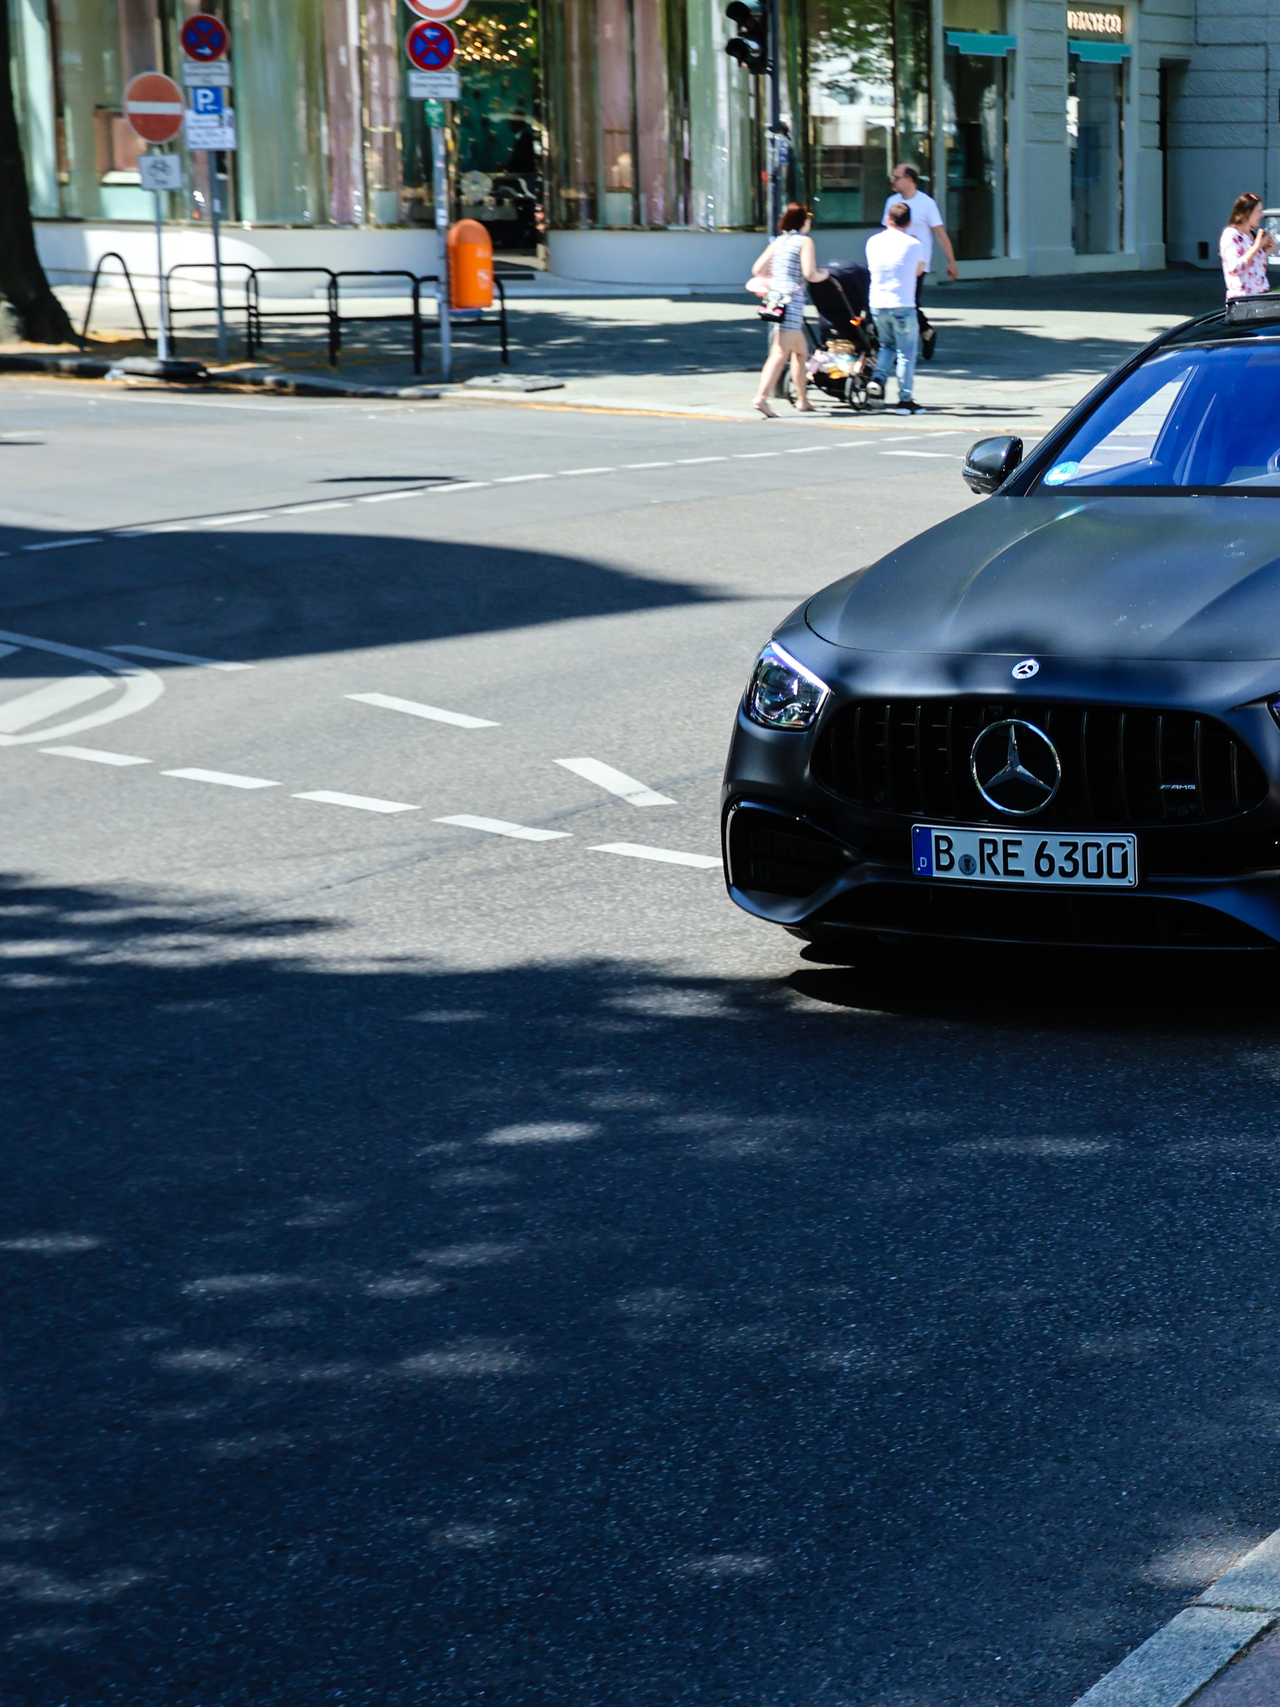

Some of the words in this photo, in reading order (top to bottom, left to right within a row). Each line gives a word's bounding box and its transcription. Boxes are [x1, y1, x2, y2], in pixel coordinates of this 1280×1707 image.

[197, 89, 215, 111] P
[934, 834, 955, 871] B
[978, 837, 1025, 876] RE
[1034, 840, 1129, 879] 6300
